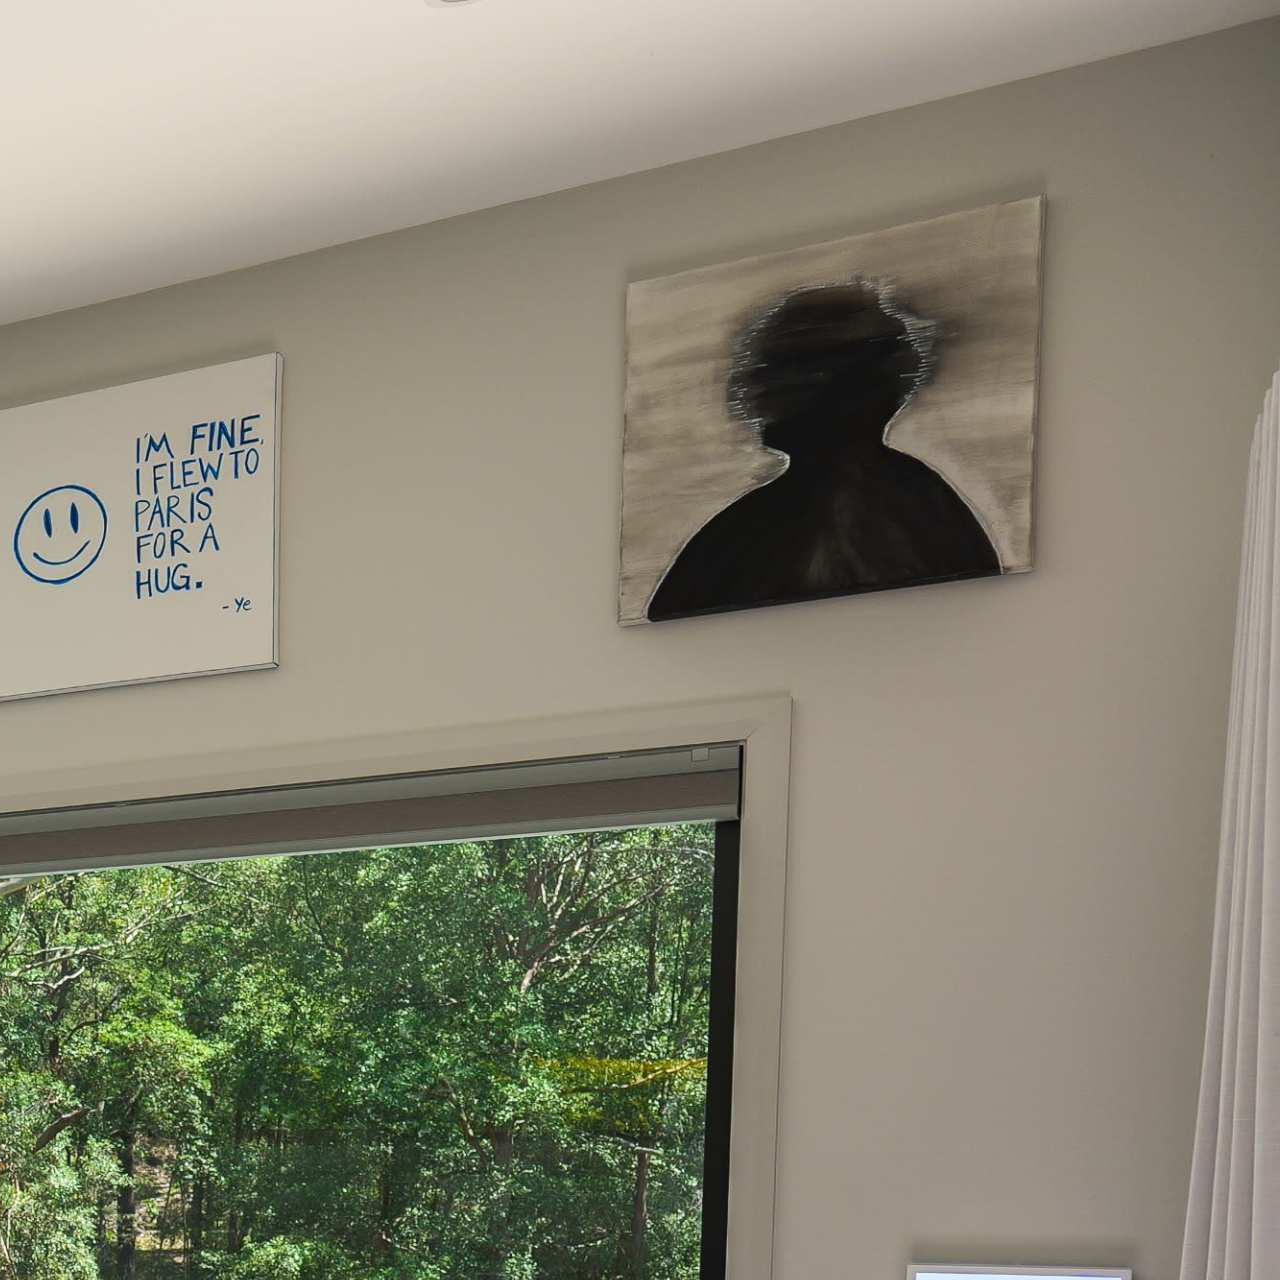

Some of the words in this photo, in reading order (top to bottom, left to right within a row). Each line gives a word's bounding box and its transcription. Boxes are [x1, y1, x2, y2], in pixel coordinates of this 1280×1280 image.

[136, 432, 175, 463] I'M
[136, 468, 141, 496] I
[153, 452, 224, 495] FLEW
[229, 448, 260, 479] TO
[135, 487, 214, 532] PARIS
[136, 528, 191, 563] FOR
[199, 522, 220, 553] A
[136, 562, 203, 600] HUG.
